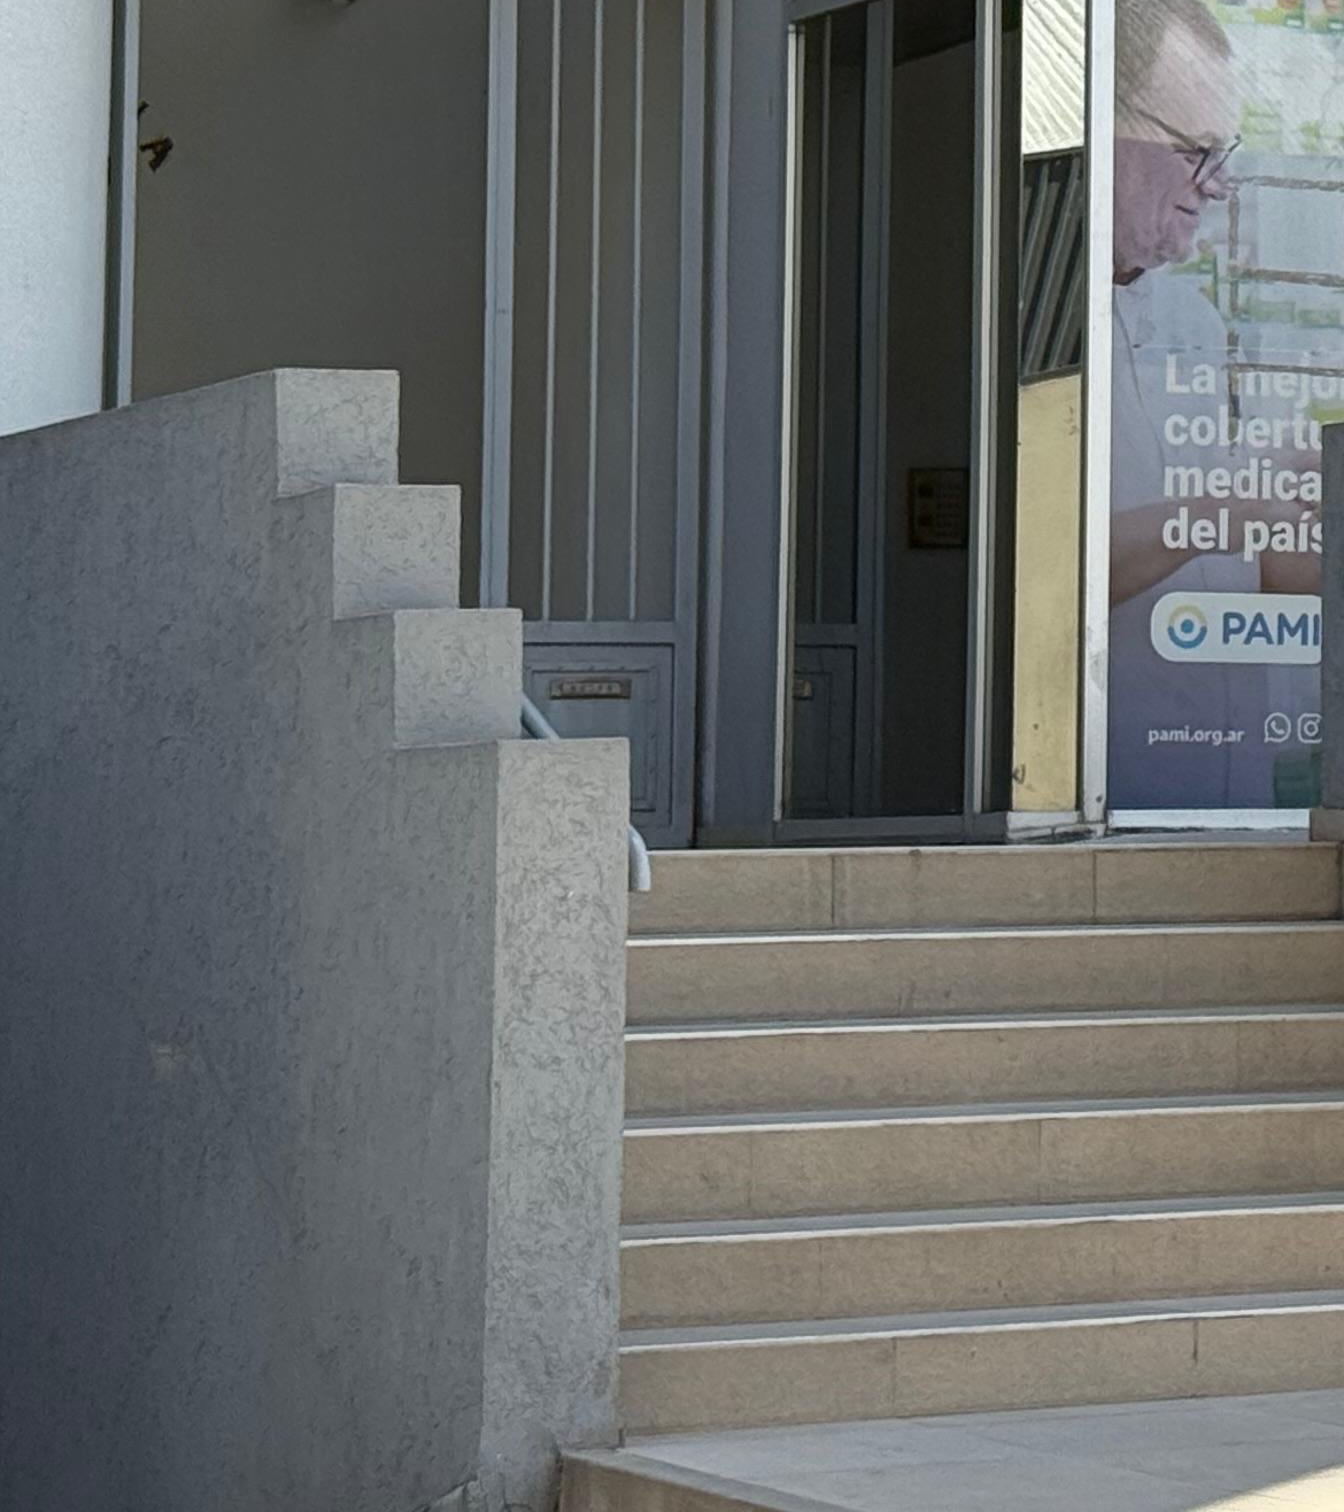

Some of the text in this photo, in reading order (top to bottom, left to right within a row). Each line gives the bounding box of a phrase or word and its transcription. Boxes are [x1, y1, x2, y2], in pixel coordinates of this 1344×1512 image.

[1165, 353, 1217, 395] La
[1163, 405, 1323, 450] cobertu
[1162, 507, 1229, 551] del
[1222, 611, 1320, 646] PAMI
[1148, 725, 1245, 746] pami.org.ar
